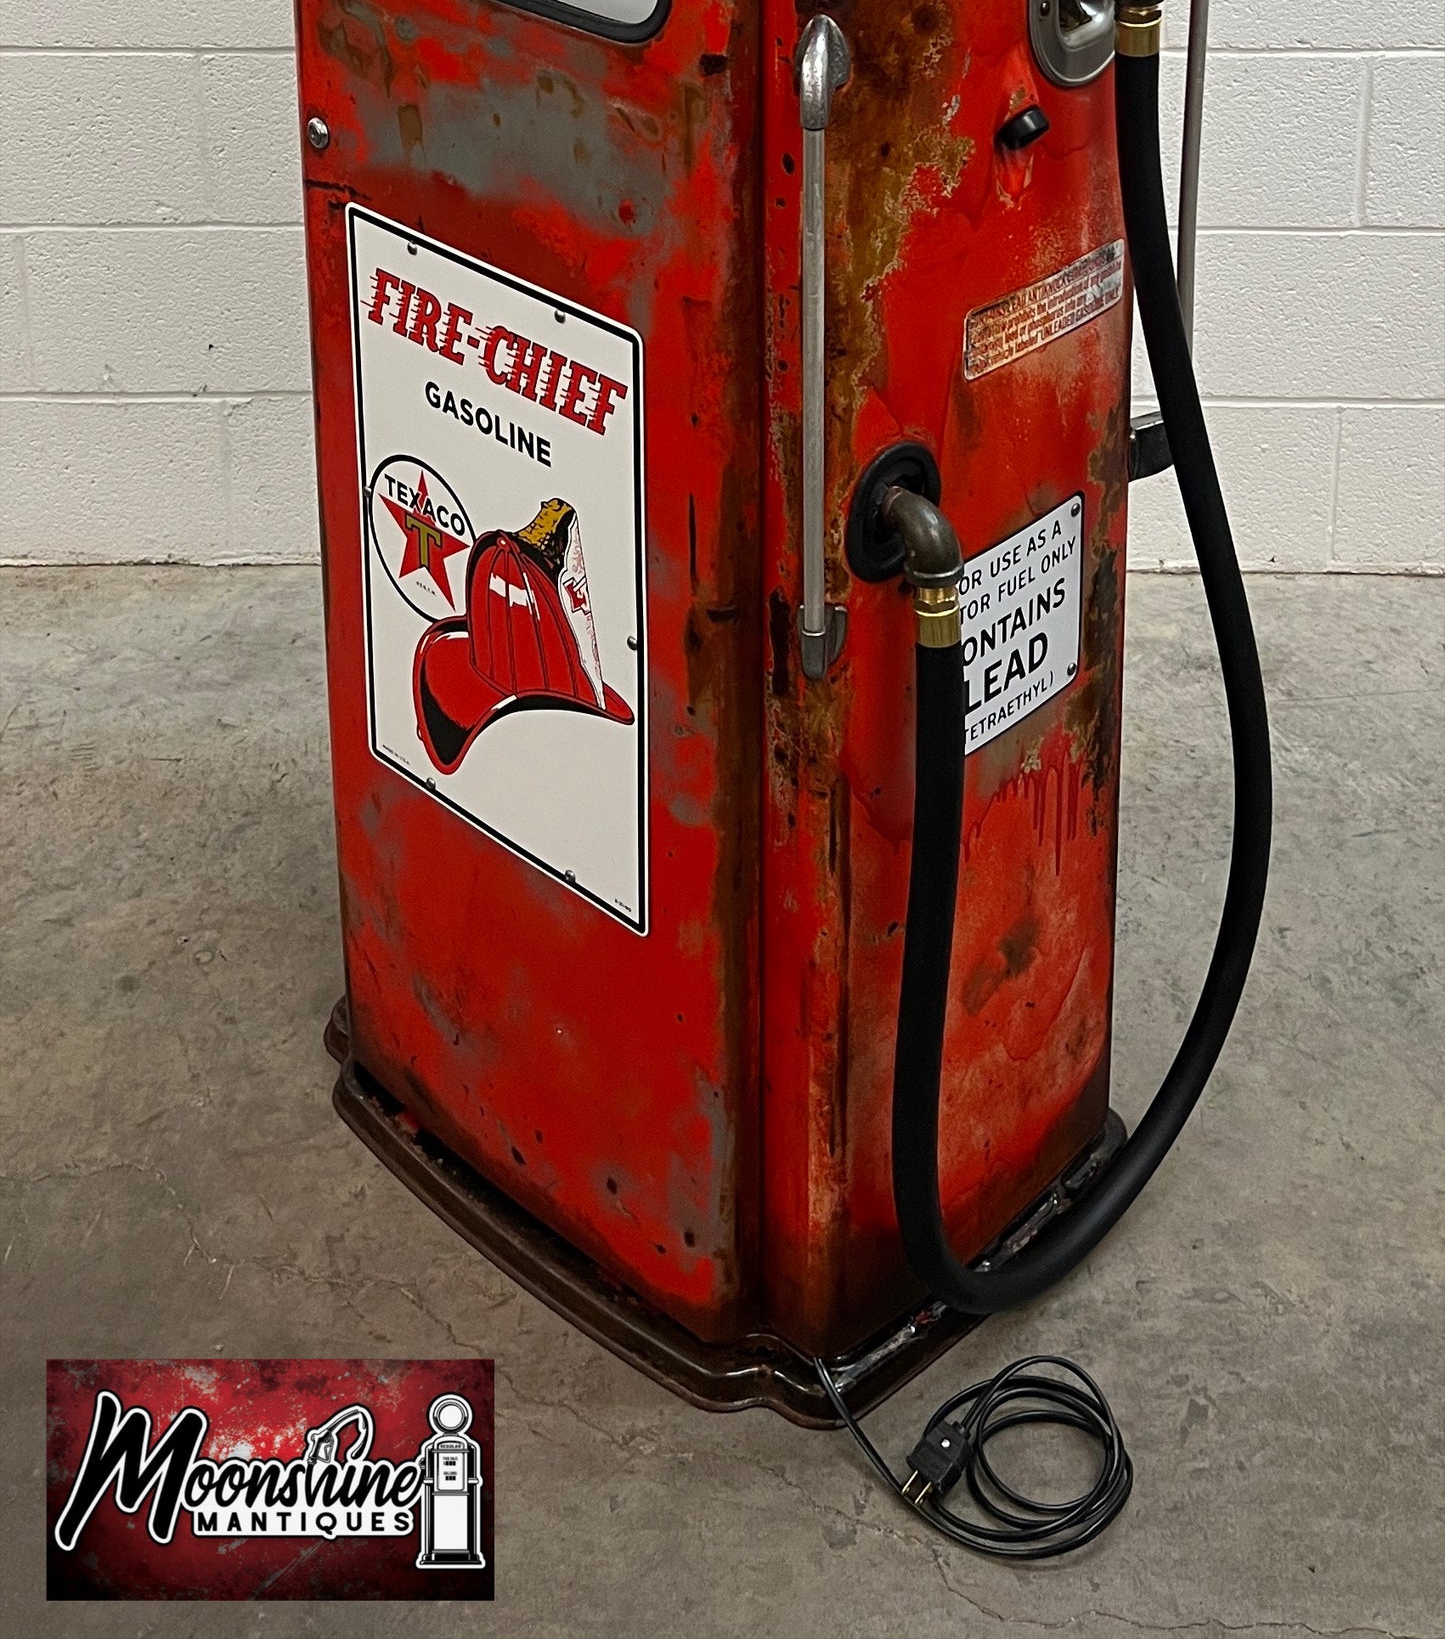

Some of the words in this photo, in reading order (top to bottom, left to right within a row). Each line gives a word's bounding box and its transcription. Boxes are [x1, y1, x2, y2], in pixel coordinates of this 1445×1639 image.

[361, 268, 628, 436] FIRE-CHIEF
[425, 381, 552, 468] GASOLINE
[384, 473, 465, 536] TEXACO
[959, 569, 982, 595] OR
[990, 545, 1021, 577] USE
[1026, 529, 1046, 556] AS
[1052, 520, 1061, 539] A
[960, 593, 990, 625] TOR
[998, 567, 1035, 602] FUEL
[1041, 536, 1076, 573] ONLY
[962, 578, 1065, 666] ONTAINS
[965, 632, 1048, 711] LEAD
